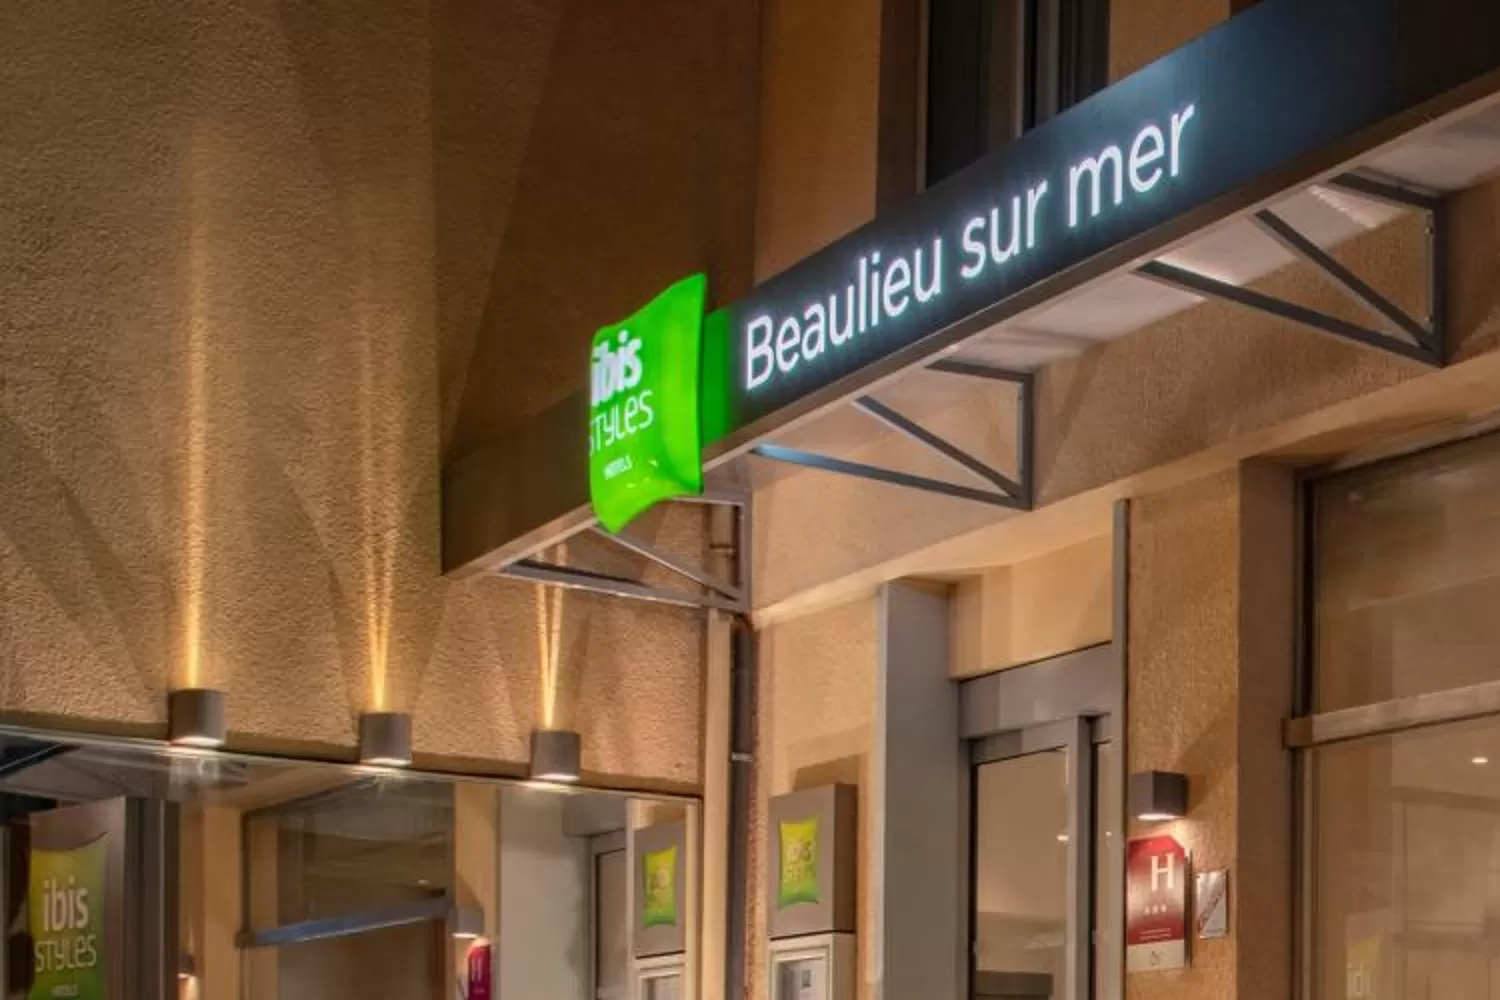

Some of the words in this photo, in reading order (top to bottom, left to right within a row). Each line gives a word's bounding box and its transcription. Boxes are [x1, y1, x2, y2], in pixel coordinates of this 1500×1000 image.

[746, 239, 942, 389] Beaulieu
[960, 180, 1048, 278] sur
[1068, 104, 1195, 227] mer
[1151, 852, 1175, 890] H
[43, 875, 89, 933] ibis
